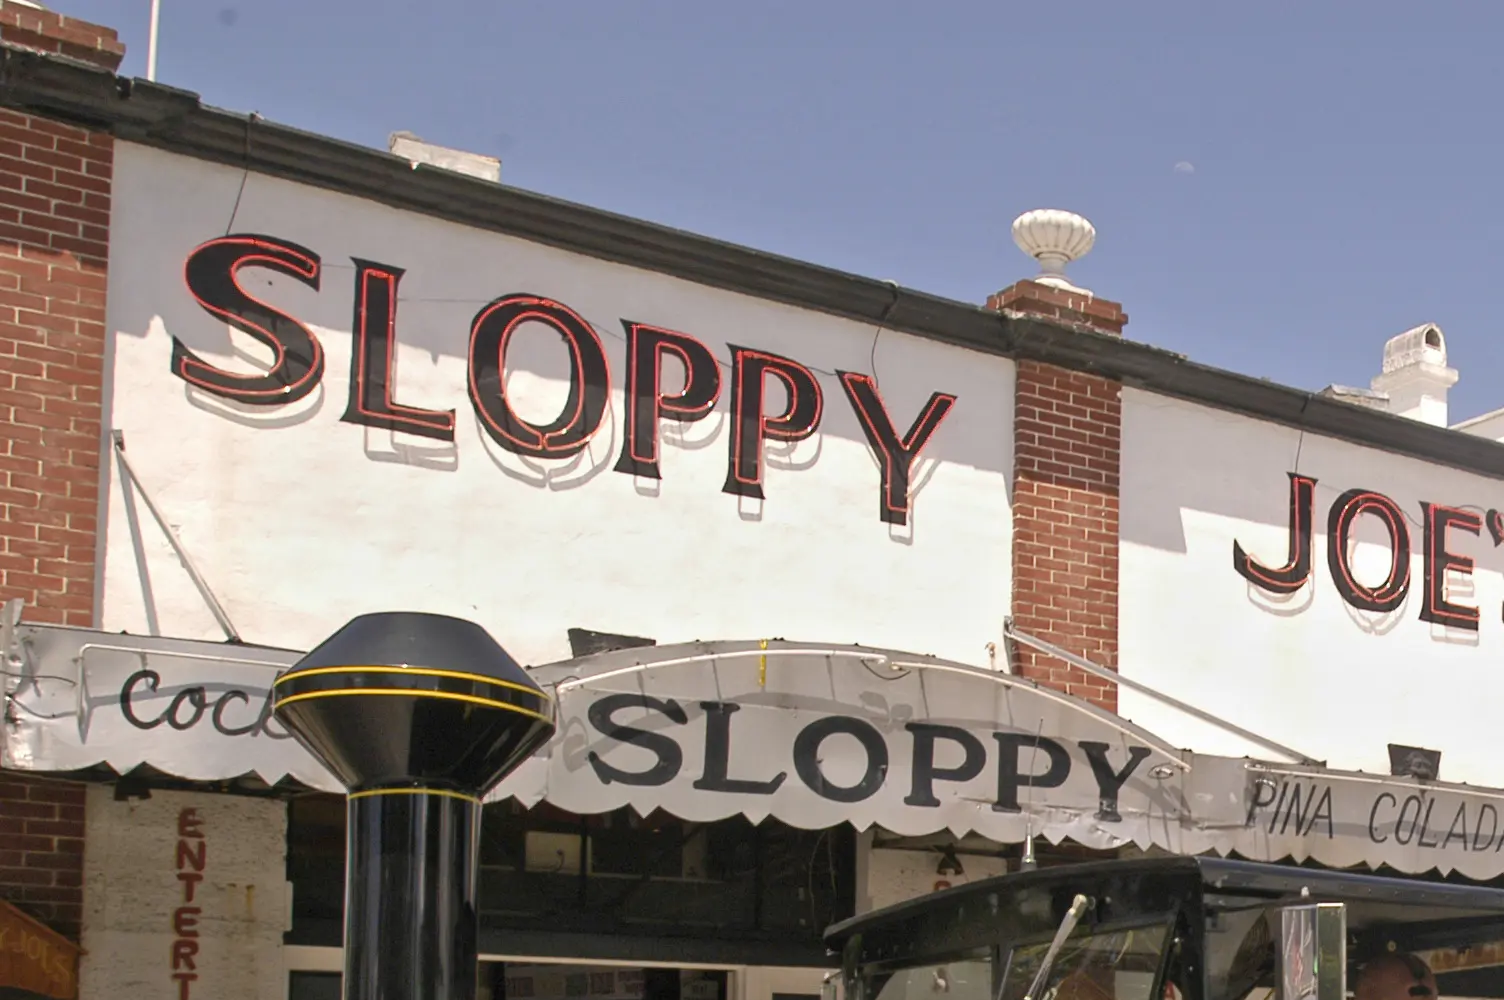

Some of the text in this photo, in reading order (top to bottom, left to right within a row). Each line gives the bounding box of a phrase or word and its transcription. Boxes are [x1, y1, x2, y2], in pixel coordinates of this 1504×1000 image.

[171, 233, 958, 527] SLOPPY
[587, 693, 1152, 823] SLOPPY
[1245, 777, 1334, 840] PINA
